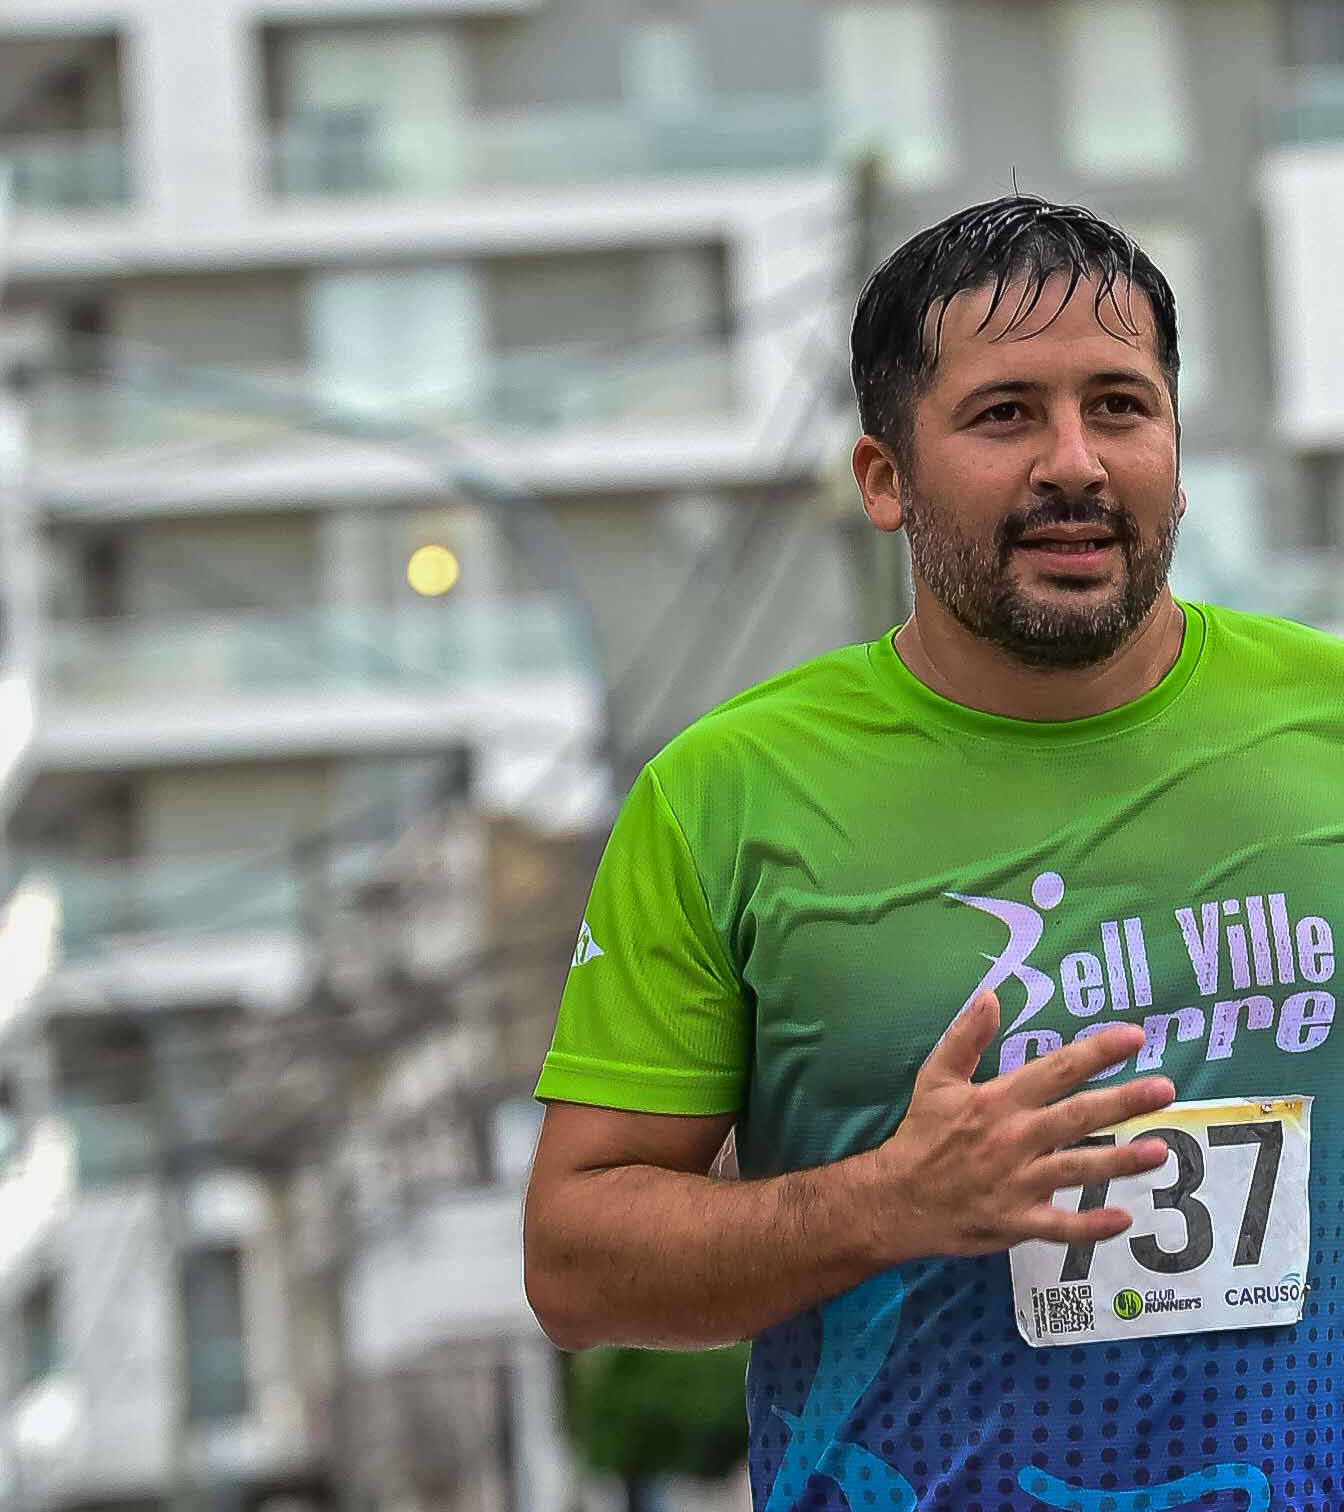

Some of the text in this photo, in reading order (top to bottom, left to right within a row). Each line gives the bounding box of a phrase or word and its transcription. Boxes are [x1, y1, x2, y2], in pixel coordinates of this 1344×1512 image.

[1175, 893, 1335, 995] Ville
[1054, 1120, 1284, 1283] 737
[1144, 1288, 1175, 1302] CLUB
[1144, 1297, 1202, 1314] RUNNER'S
[1224, 1284, 1300, 1306] CARUSO
